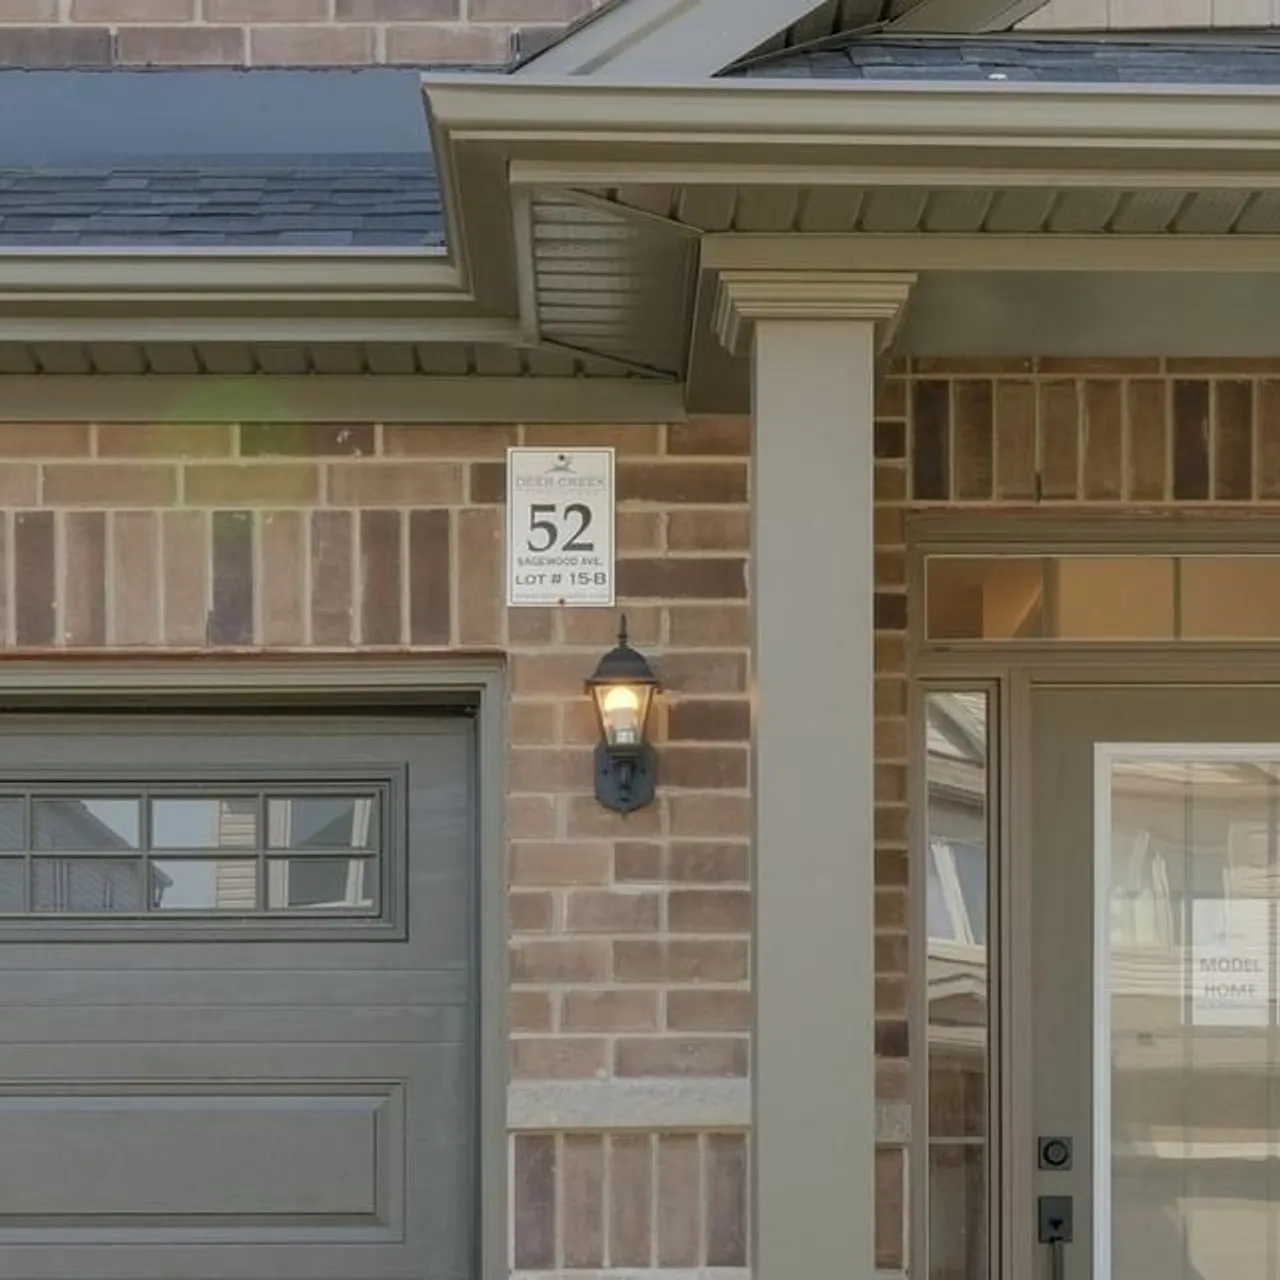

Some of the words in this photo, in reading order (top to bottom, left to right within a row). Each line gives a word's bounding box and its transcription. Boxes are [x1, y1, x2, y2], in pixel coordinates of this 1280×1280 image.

[528, 504, 594, 552] 52
[516, 574, 546, 585] LOT
[552, 574, 561, 585] #
[569, 572, 607, 585] 15-B
[1200, 958, 1263, 973] MODEL
[1204, 983, 1258, 997] HOME
